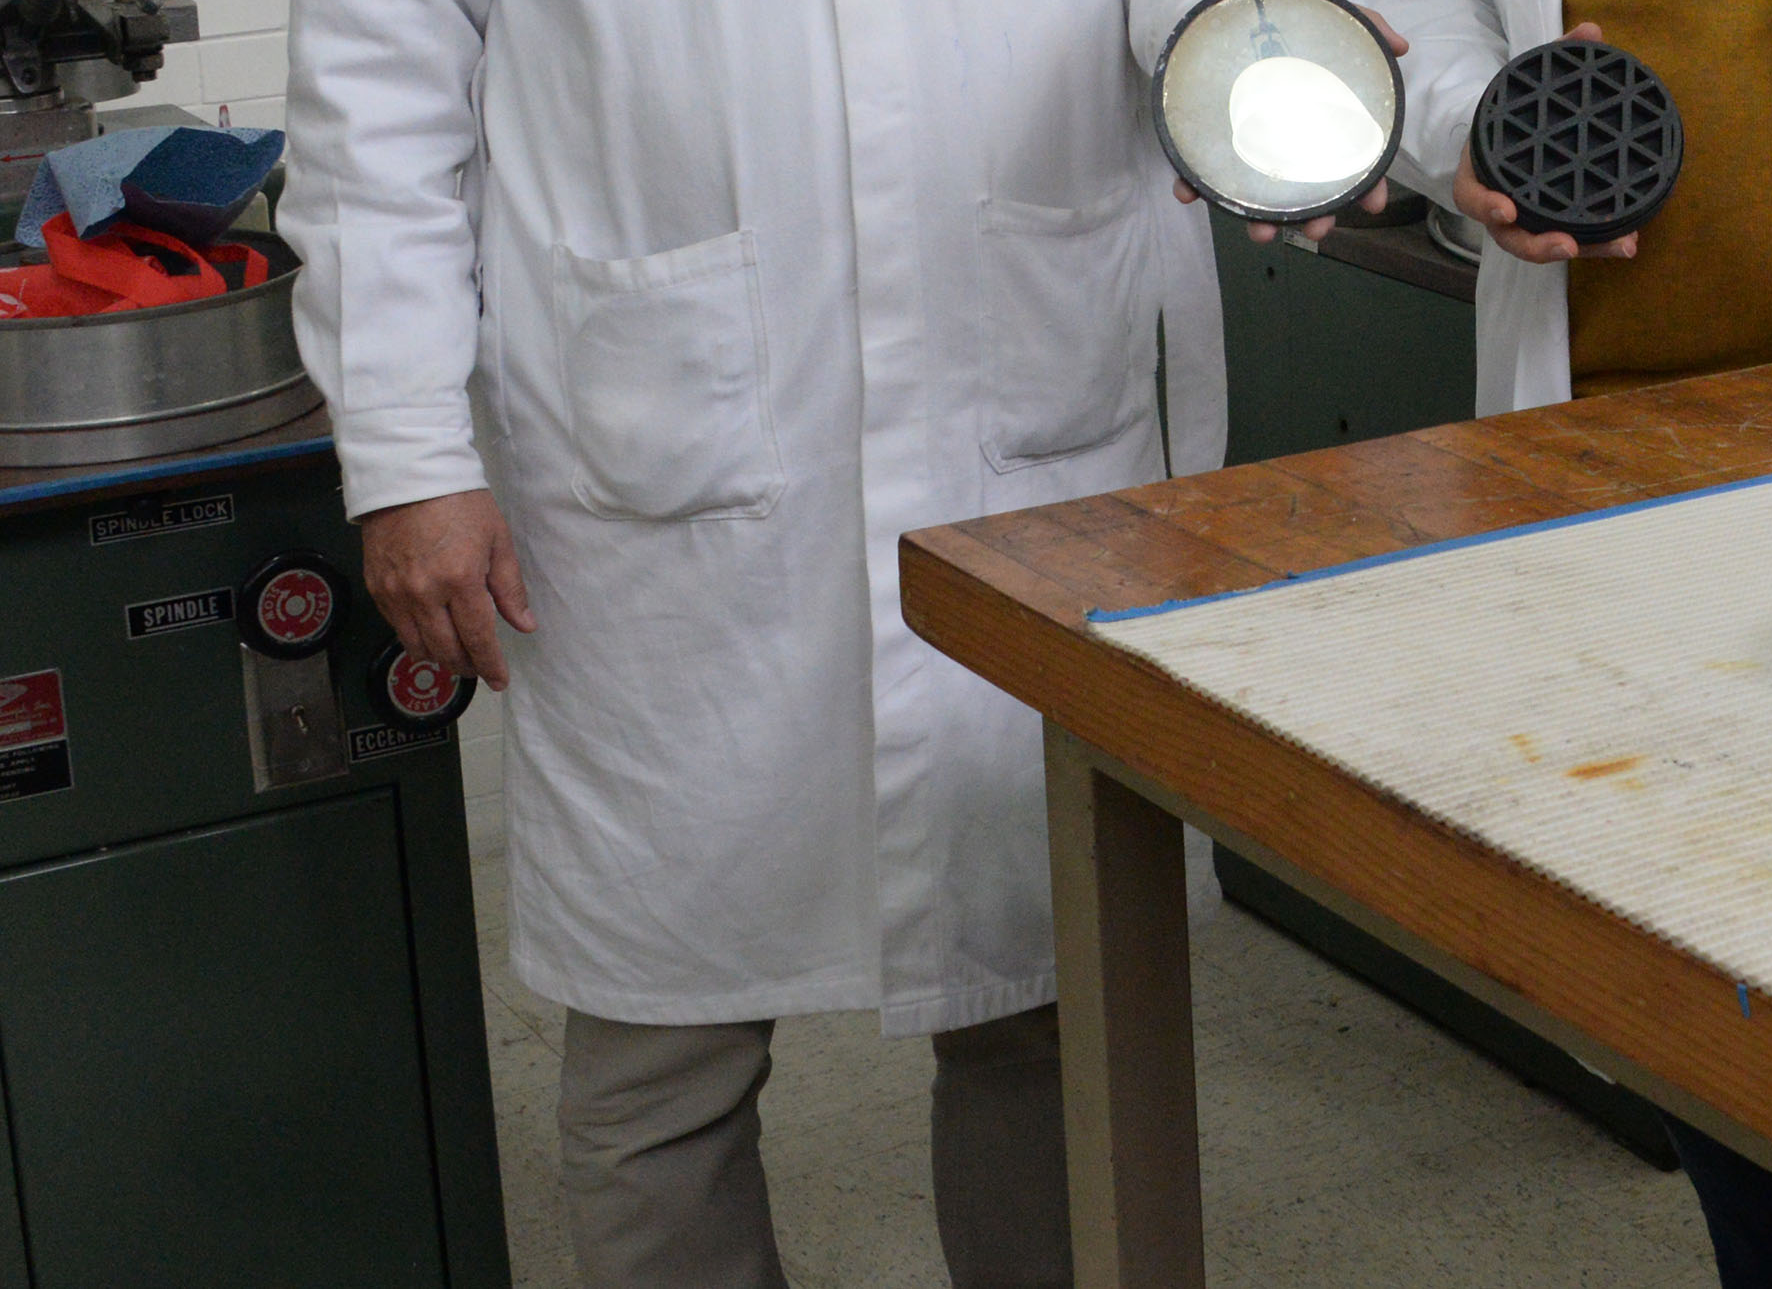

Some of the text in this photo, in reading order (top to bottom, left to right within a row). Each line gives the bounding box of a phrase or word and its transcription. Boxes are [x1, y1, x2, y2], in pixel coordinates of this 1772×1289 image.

[181, 501, 227, 522] LOCK
[143, 596, 219, 628] SPINDLE
[264, 586, 281, 621] SLOW
[312, 591, 328, 623] FAST
[355, 729, 443, 752] ECCEN
